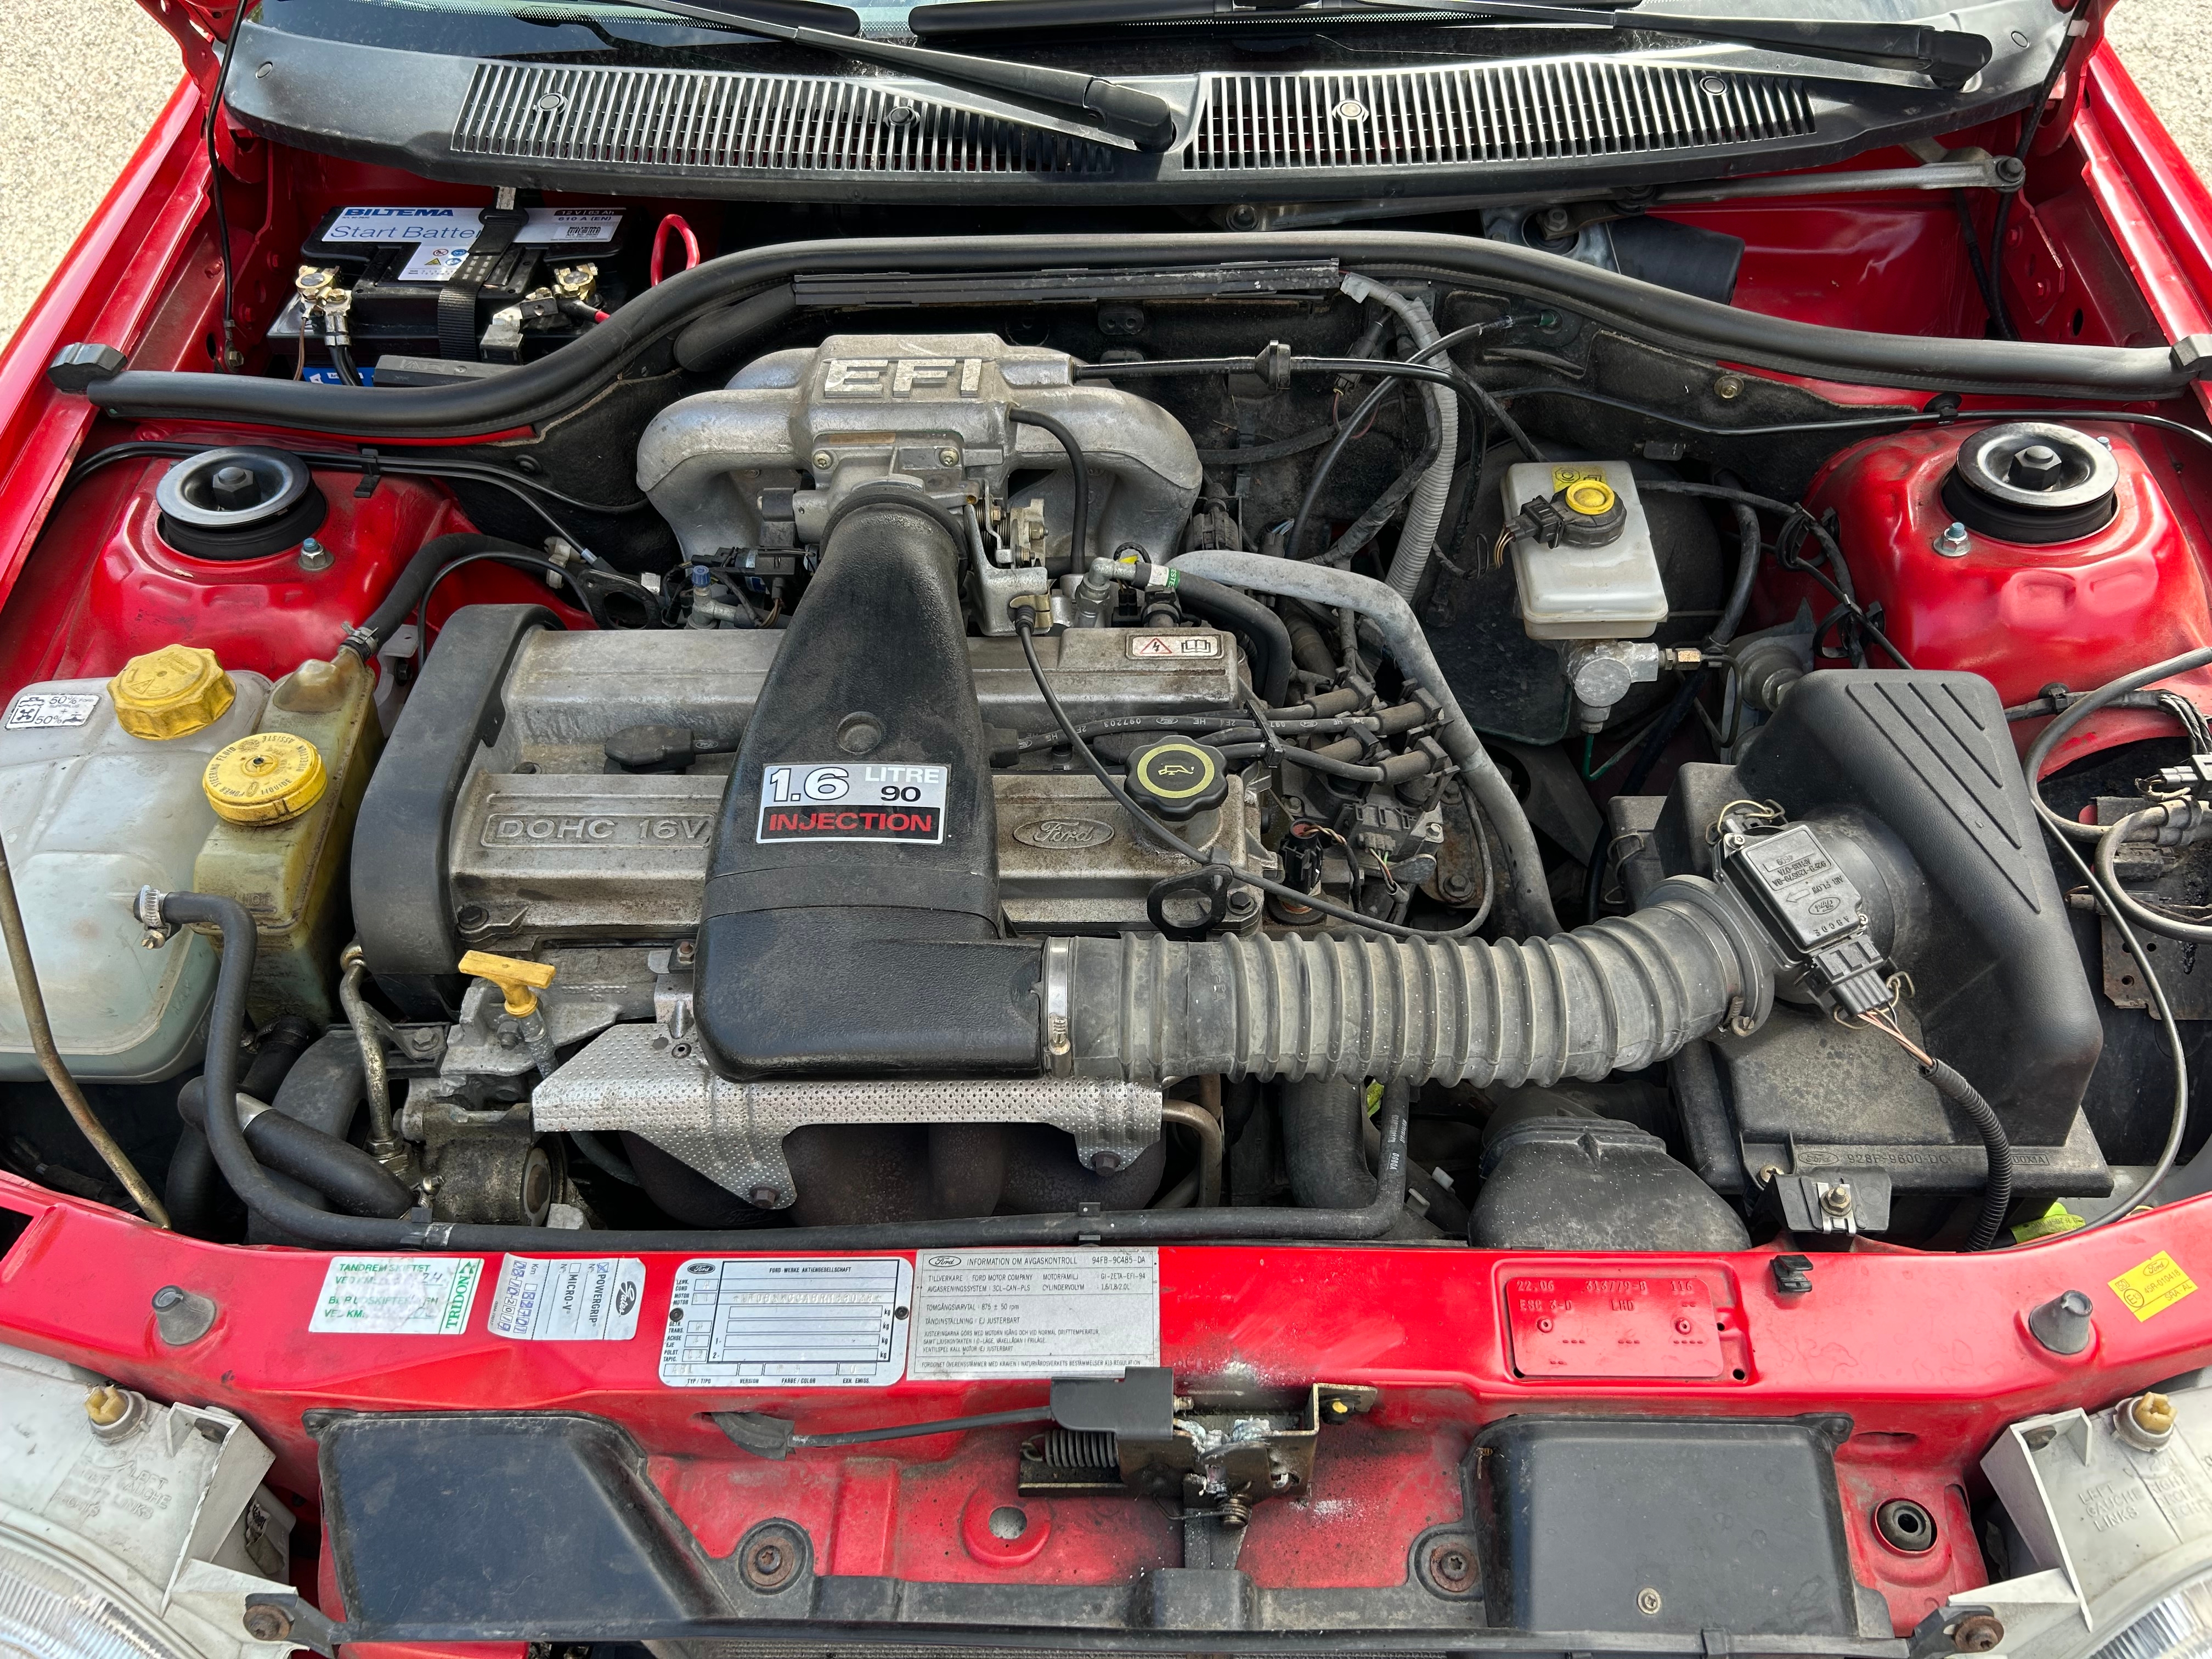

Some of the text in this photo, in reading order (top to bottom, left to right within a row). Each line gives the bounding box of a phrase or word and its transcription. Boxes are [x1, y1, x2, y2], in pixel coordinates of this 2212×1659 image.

[331, 226, 397, 238] Start
[825, 359, 982, 398] EFI
[49, 696, 77, 704] 50%
[35, 715, 62, 724] 50%
[1103, 718, 1141, 727] 097203
[1045, 732, 1058, 741] HE
[296, 745, 309, 772] DIRECTION
[210, 764, 222, 787] STEERING
[770, 766, 940, 802] 1.6 LITRE
[220, 787, 245, 797] POWER
[881, 786, 921, 802] 90
[496, 819, 708, 839] DOHC 16V
[769, 812, 932, 831] INJECTION
[1033, 822, 1094, 843] Ford
[1776, 854, 1793, 866] 4E09
[1812, 875, 1843, 894] AIR FLOW
[1815, 899, 1834, 913] Ford
[529, 1263, 540, 1275] Km
[2148, 1261, 2164, 1274] Ford
[1516, 1280, 1555, 1291] 22.06
[1671, 1281, 1692, 1291] 116
[2117, 1281, 2128, 1290] 50
[2145, 1269, 2181, 1294] 45R-010418
[562, 1274, 579, 1311] MICRO-V
[589, 1274, 607, 1323] POWERGRIP
[616, 1281, 637, 1316] Gates
[445, 1276, 471, 1329] TRIDON
[1612, 1299, 1634, 1311] LHD
[2078, 1482, 2115, 1504] LEFT
[2094, 1507, 2139, 1532] LINKS
